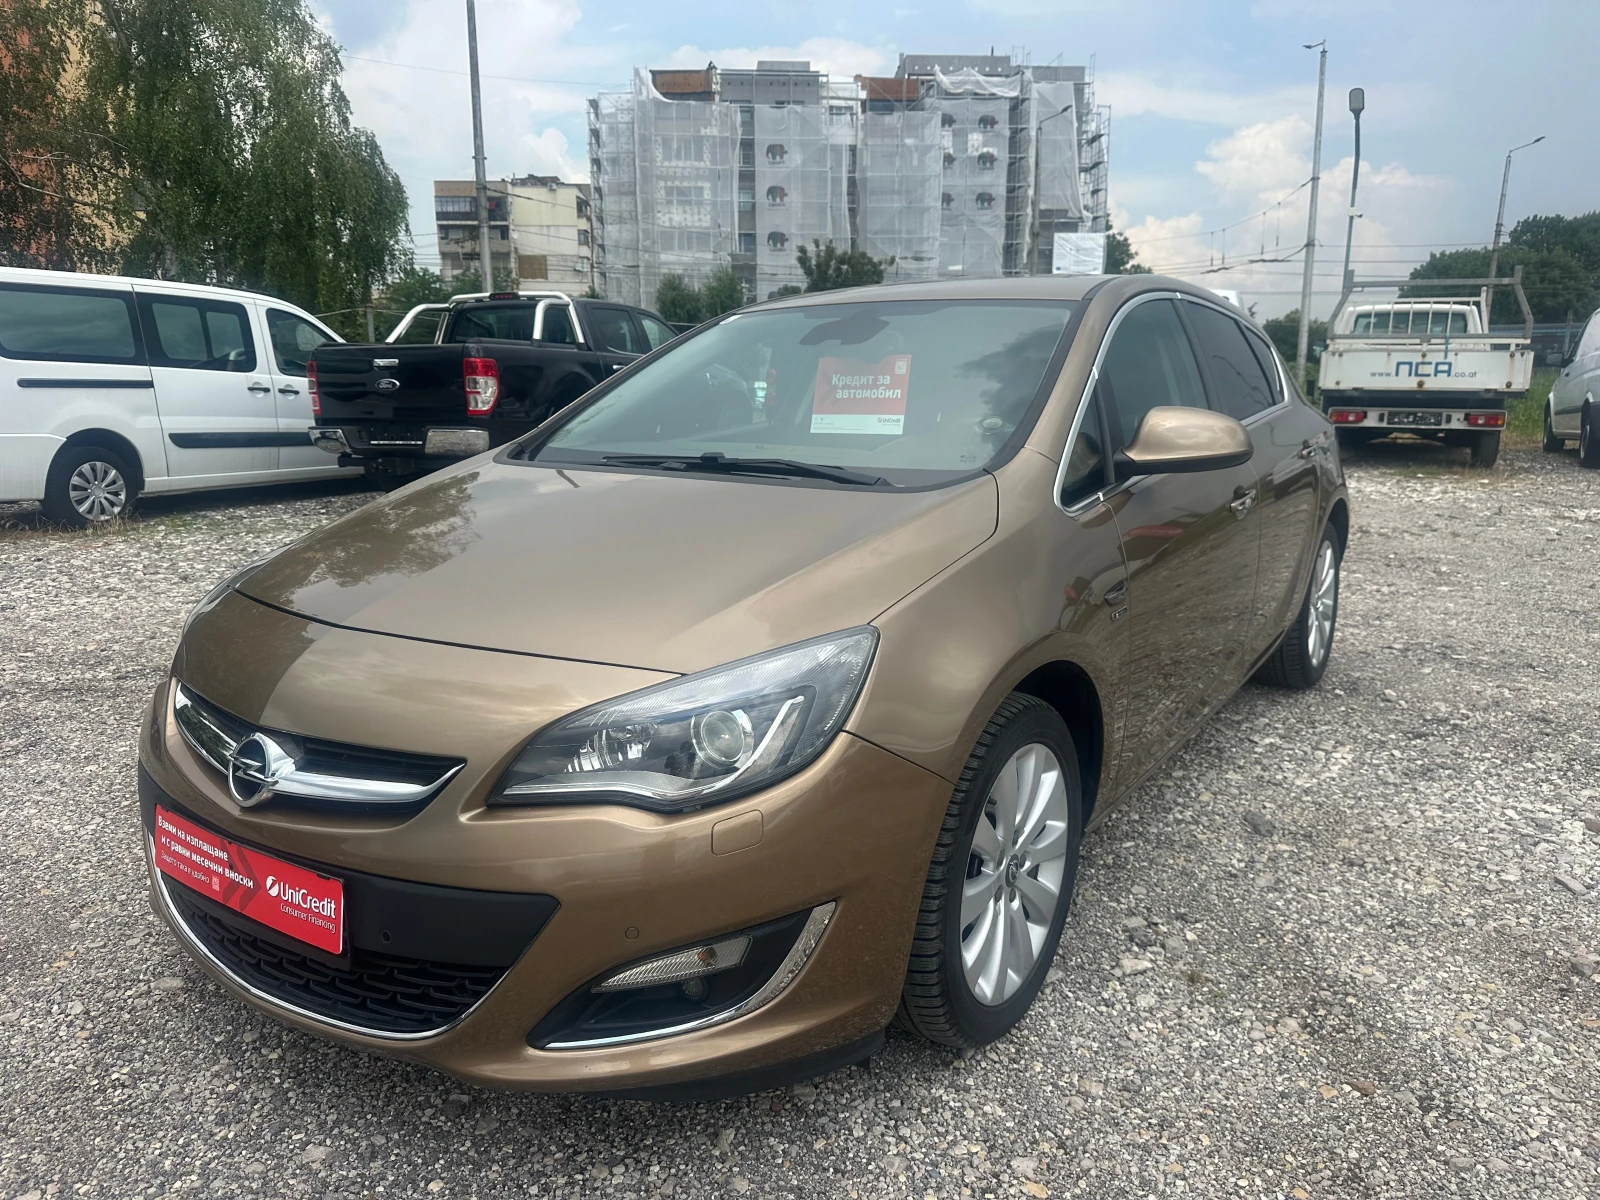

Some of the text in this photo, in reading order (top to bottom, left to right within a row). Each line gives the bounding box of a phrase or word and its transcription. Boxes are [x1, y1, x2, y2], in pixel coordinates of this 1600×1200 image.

[832, 374, 891, 387] Кредит за
[836, 386, 902, 399] автомобил
[158, 815, 228, 861] Вземи на изплащане
[171, 841, 190, 858] равни
[191, 852, 223, 874] месечни
[224, 868, 254, 889] вноски
[280, 881, 336, 919] UniCredit
[280, 903, 336, 934] Consumer Financing
